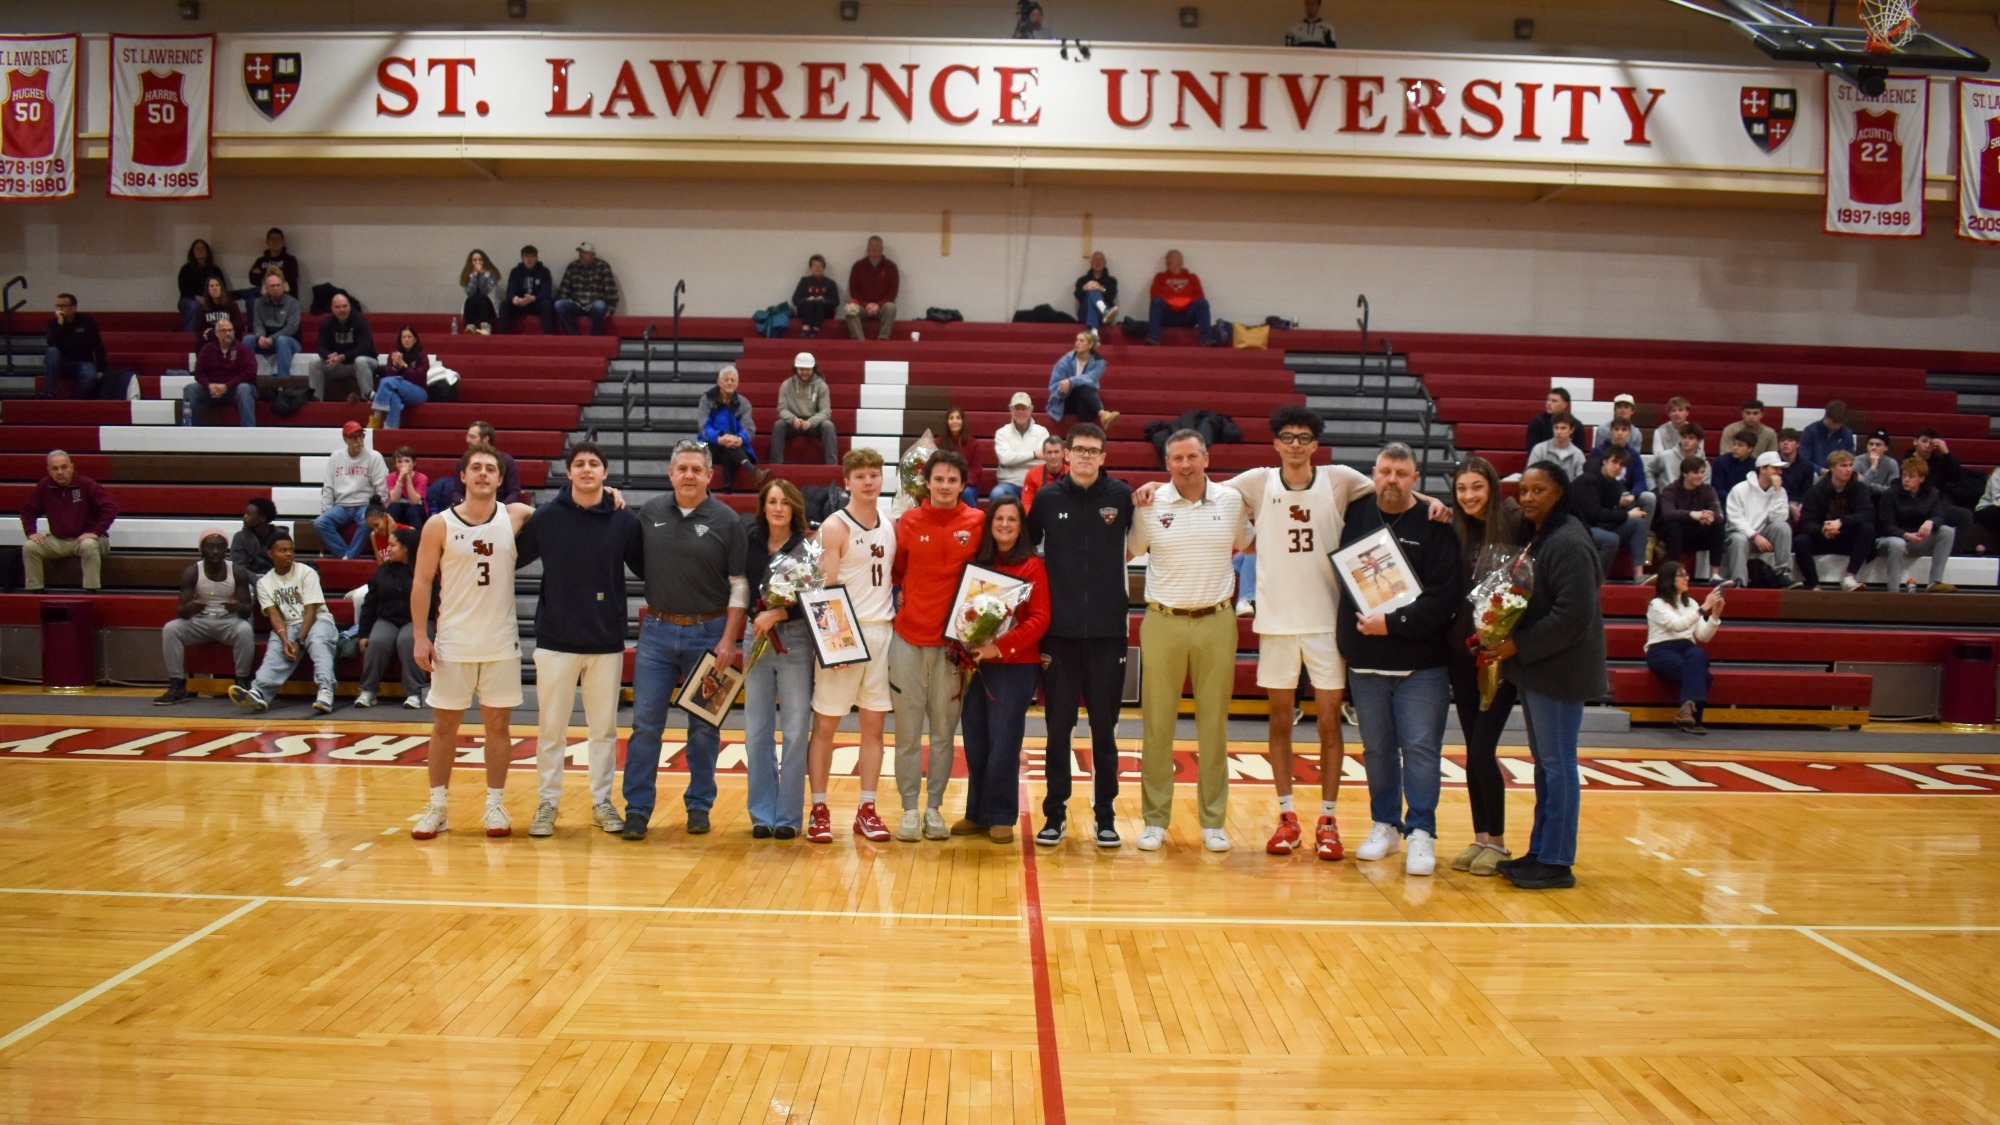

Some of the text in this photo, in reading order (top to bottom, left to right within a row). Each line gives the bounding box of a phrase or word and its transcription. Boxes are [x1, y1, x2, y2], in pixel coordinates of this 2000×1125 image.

[7, 48, 68, 66] LAWRENCE
[123, 48, 204, 65] ST. LAWRENCE
[12, 87, 45, 102] HUGHES
[144, 88, 178, 103] HARRIS
[376, 55, 1666, 147] ST. LAWRENCE UNIVERSITY
[1972, 92, 1986, 109] ST.
[15, 102, 41, 122] 50
[148, 103, 175, 124] 50
[1857, 127, 1893, 143] ACUNTO
[1860, 142, 1889, 162] 22
[1289, 504, 1311, 523] SU
[472, 539, 494, 557] SU
[1288, 528, 1314, 553] 33
[870, 543, 885, 558] SU
[477, 562, 491, 587] 3
[871, 563, 883, 587] 11
